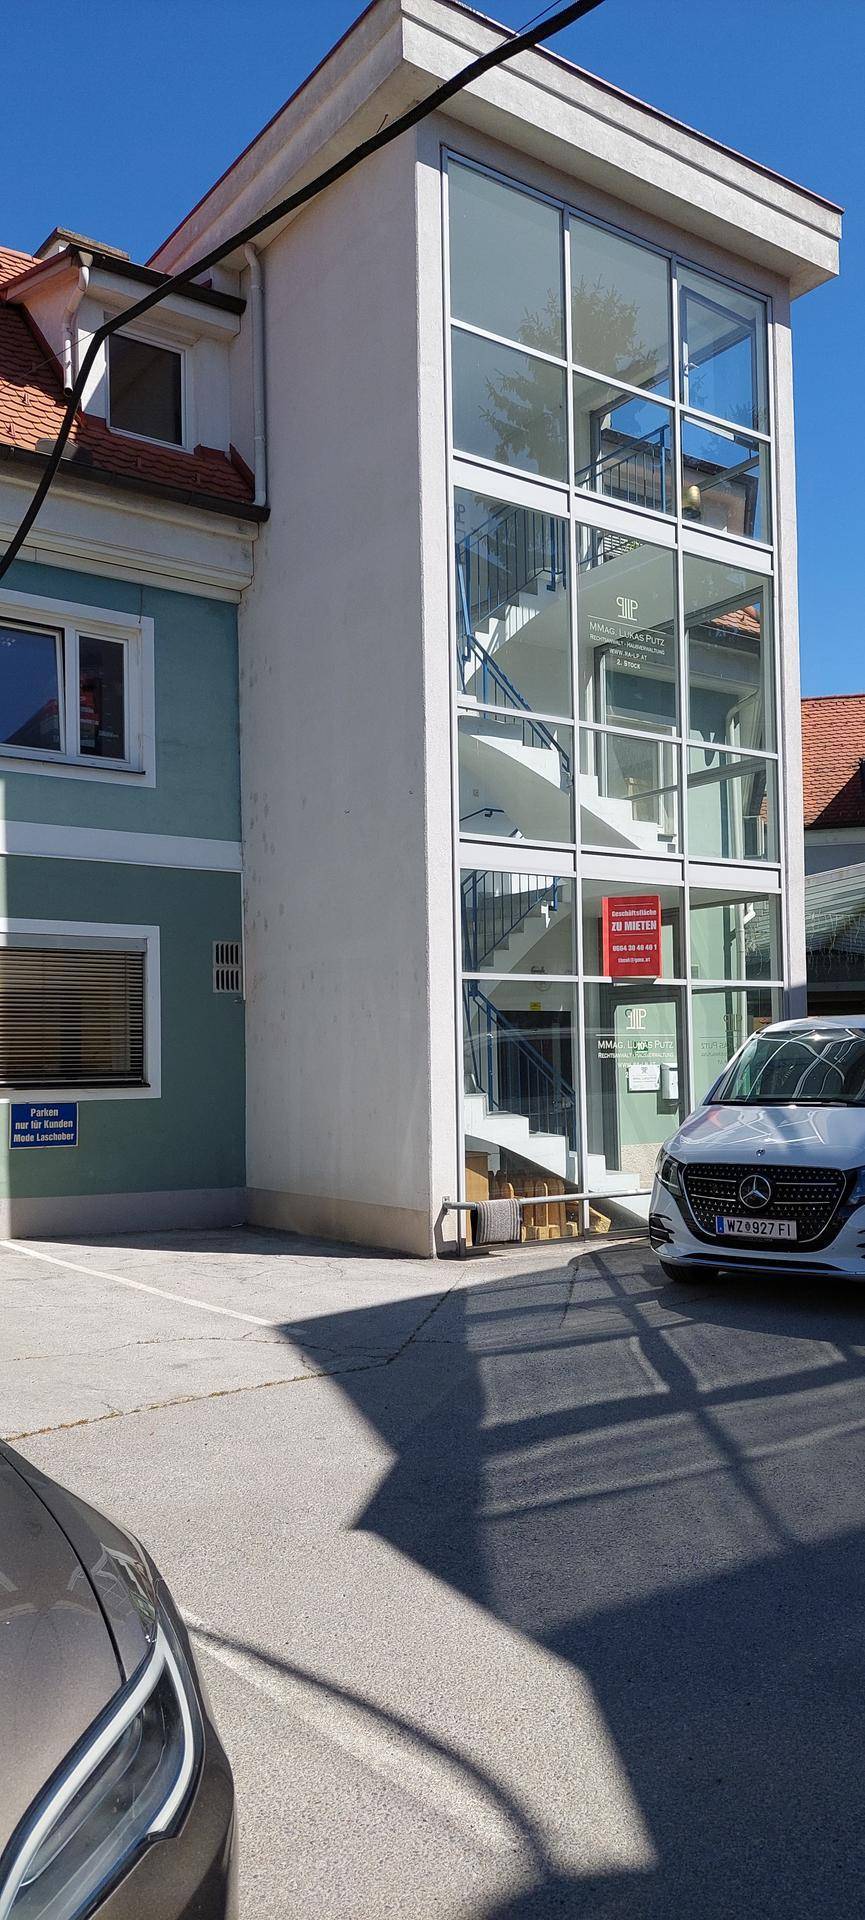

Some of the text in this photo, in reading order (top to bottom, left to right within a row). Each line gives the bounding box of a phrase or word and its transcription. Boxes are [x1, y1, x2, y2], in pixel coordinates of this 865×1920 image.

[611, 920, 657, 931] ZU MIETEN
[30, 1108, 59, 1117] Parken
[15, 1119, 73, 1130] nur für Kunden
[13, 1132, 75, 1143] Mode Laschober
[726, 1219, 744, 1233] WZ
[752, 1221, 775, 1236] 927
